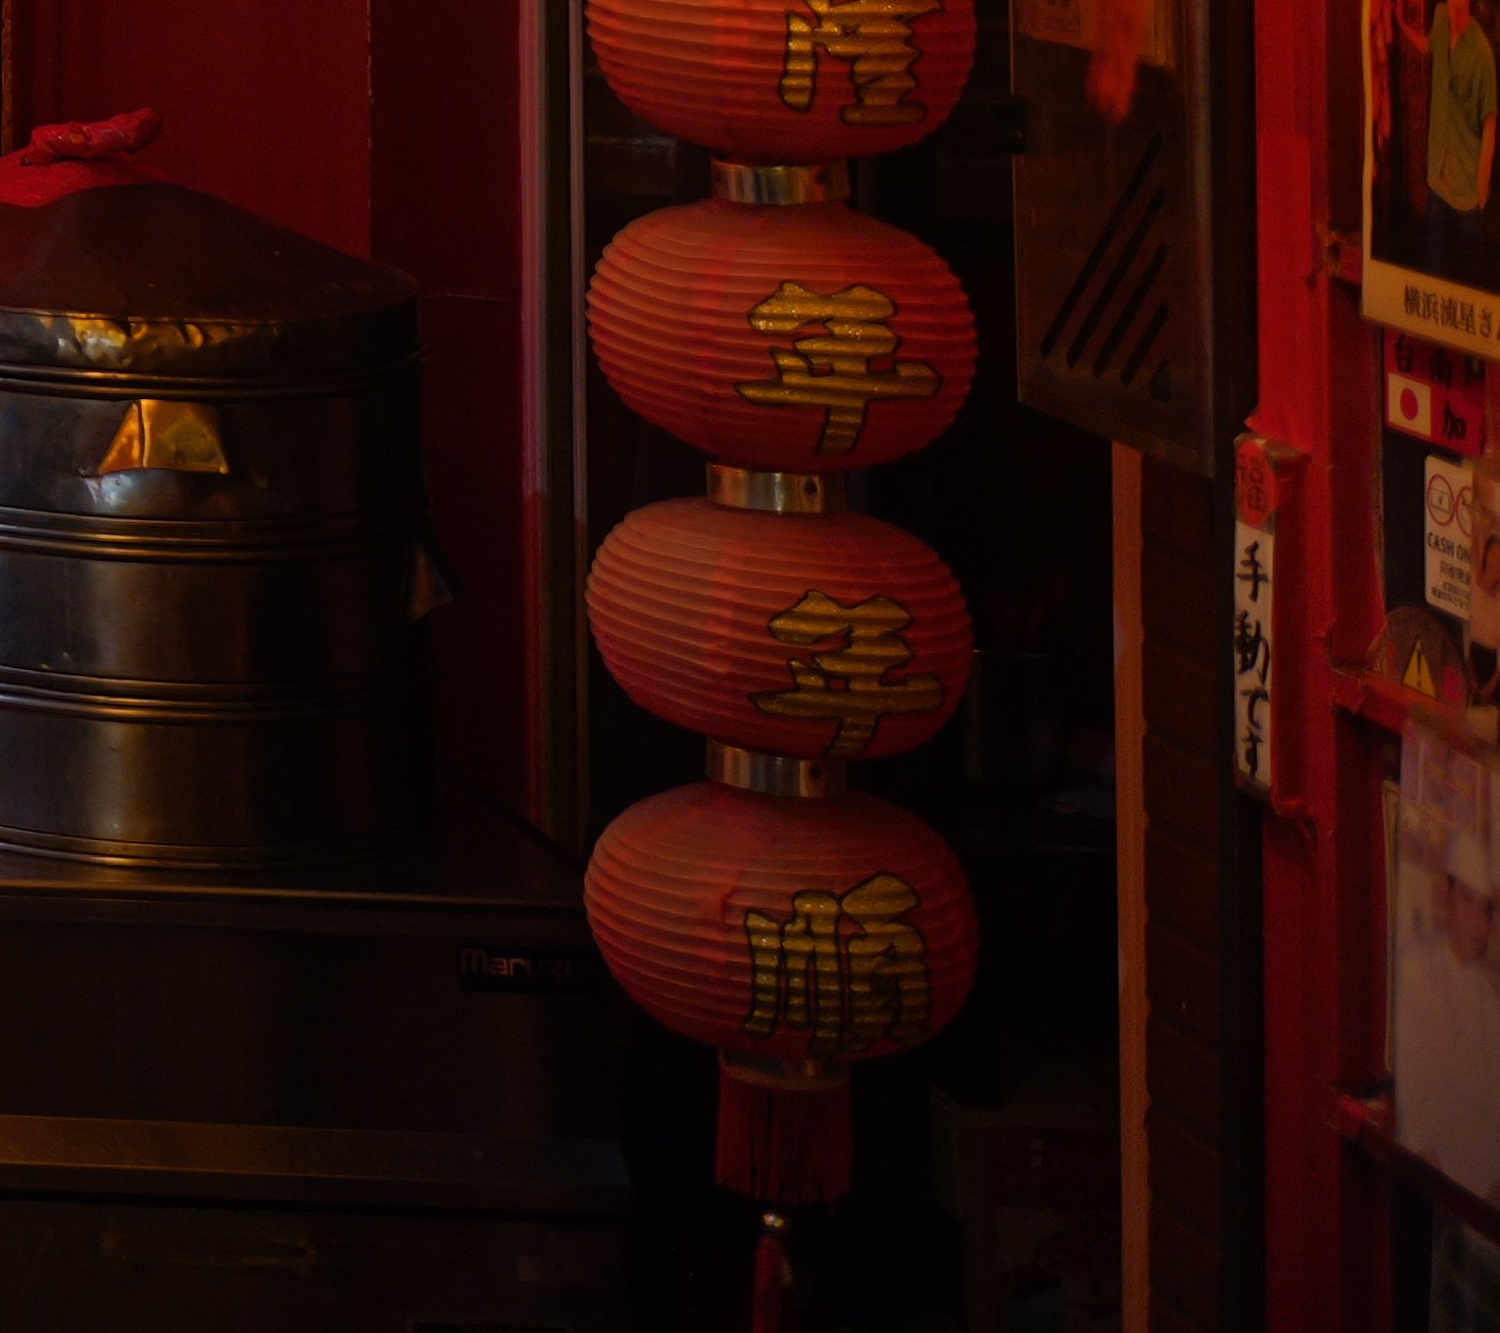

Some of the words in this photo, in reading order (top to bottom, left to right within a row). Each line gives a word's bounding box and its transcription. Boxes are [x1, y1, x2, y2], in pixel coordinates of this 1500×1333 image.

[1404, 283, 1500, 341] 横浜流星さ
[1234, 539, 1271, 777] 手動です
